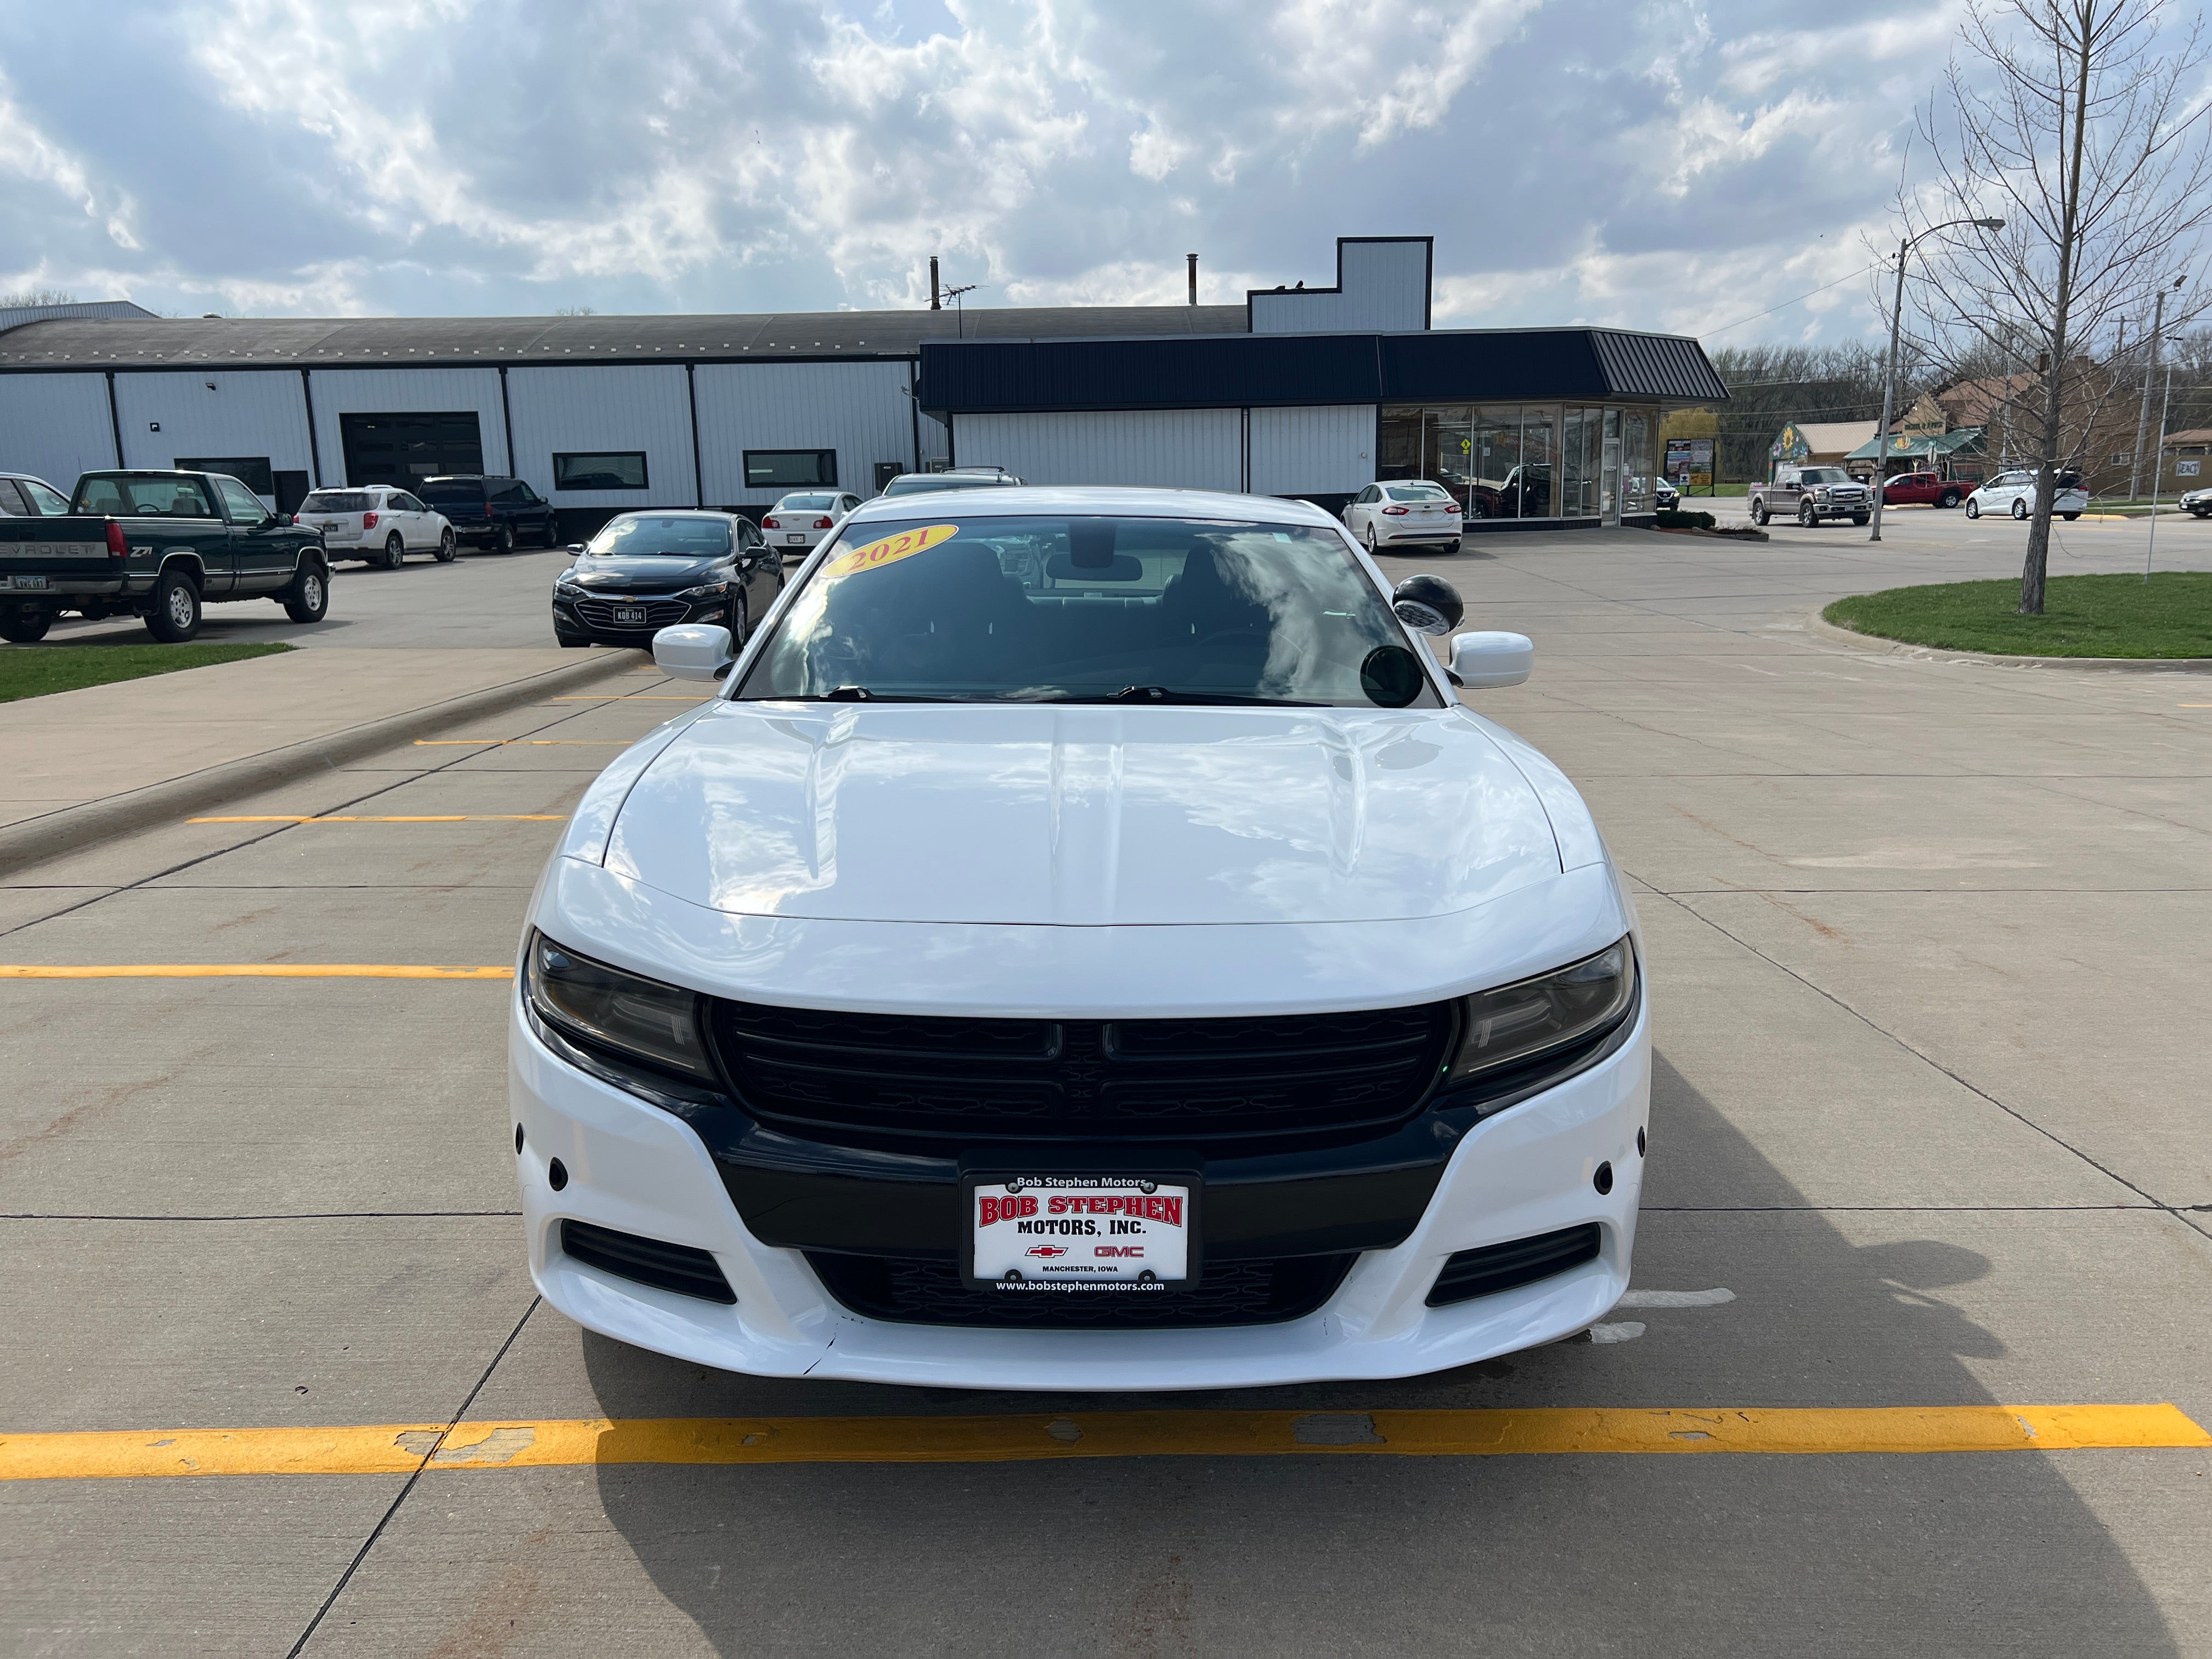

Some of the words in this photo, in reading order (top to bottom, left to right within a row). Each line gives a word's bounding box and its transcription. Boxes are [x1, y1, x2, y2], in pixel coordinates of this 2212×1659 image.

[130, 546, 153, 557] Z71
[848, 529, 928, 572] 2021
[631, 611, 642, 620] 414
[1017, 1177, 1042, 1187] Bob
[1045, 1177, 1098, 1188] Stephen
[1101, 1178, 1147, 1187] Motors
[979, 1195, 1039, 1228] BOB
[1048, 1195, 1183, 1228] STEPHEN
[1017, 1220, 1102, 1238] MOTORS,
[1109, 1220, 1147, 1234] INC.
[1094, 1246, 1144, 1258] GMC
[996, 1281, 1165, 1293] www.bobstephenmotors.com
